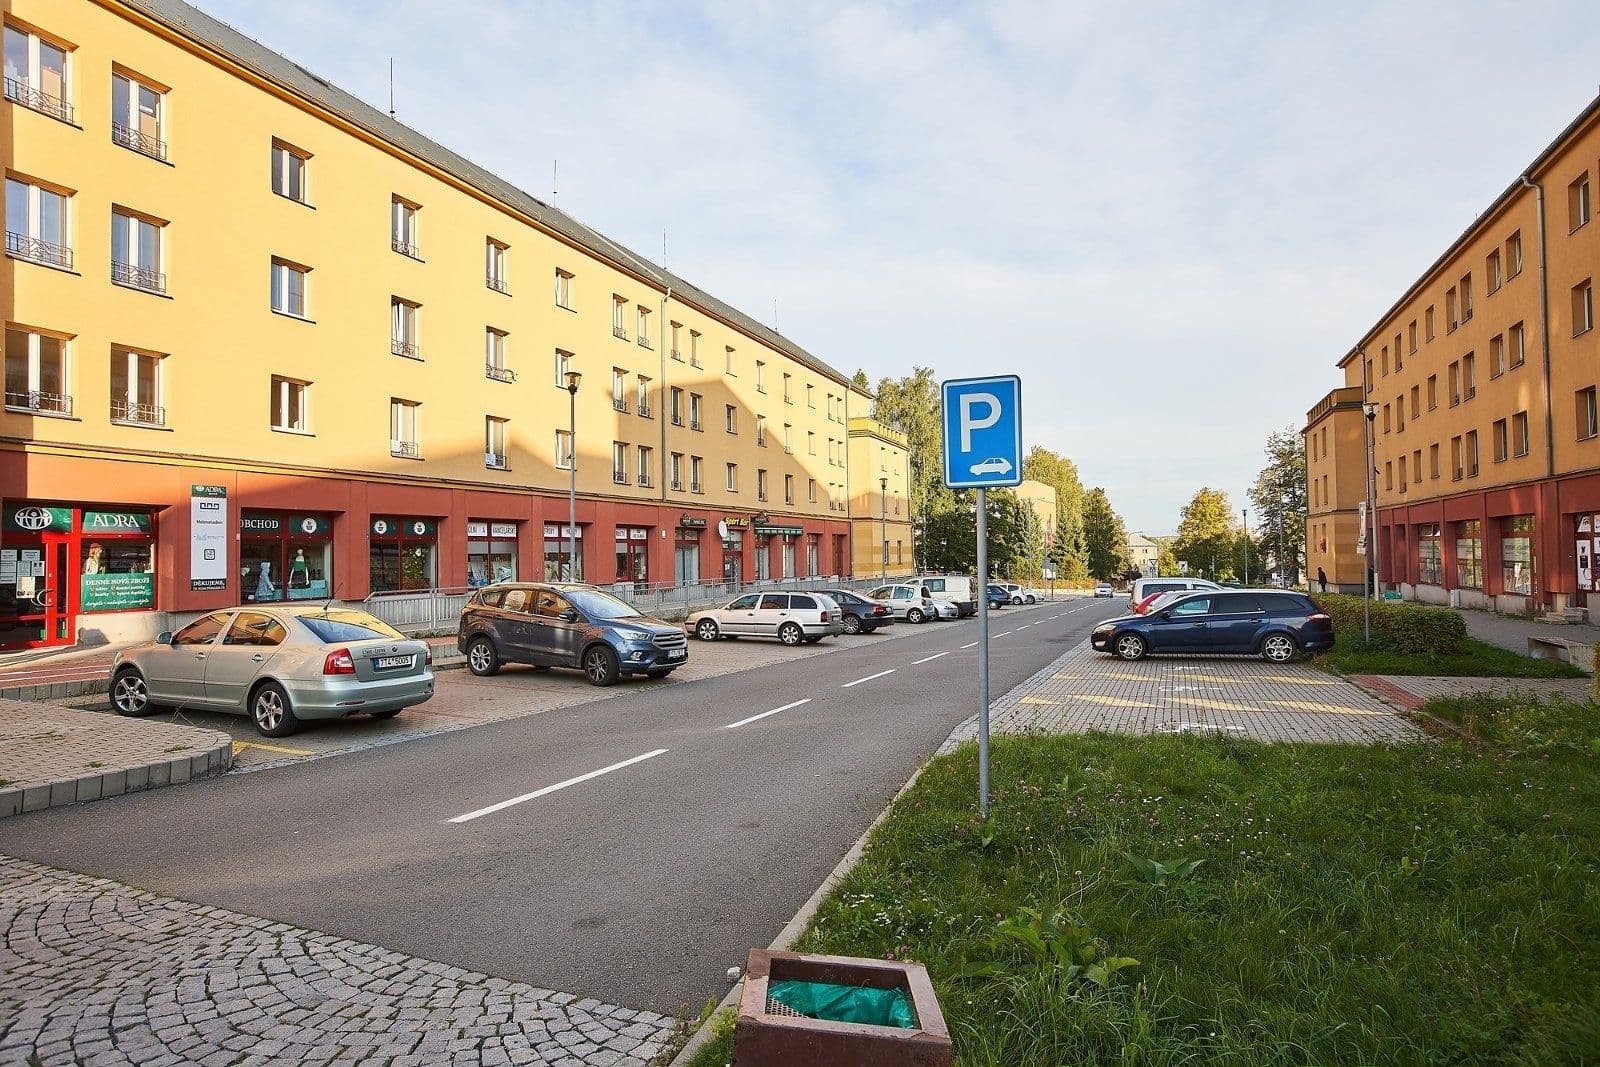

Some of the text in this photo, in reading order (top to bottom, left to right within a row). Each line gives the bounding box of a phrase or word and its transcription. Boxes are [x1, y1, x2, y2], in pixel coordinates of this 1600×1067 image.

[960, 393, 1002, 453] P
[92, 514, 141, 528] ADRA
[725, 517, 739, 527] Sport
[740, 518, 749, 526] Bar
